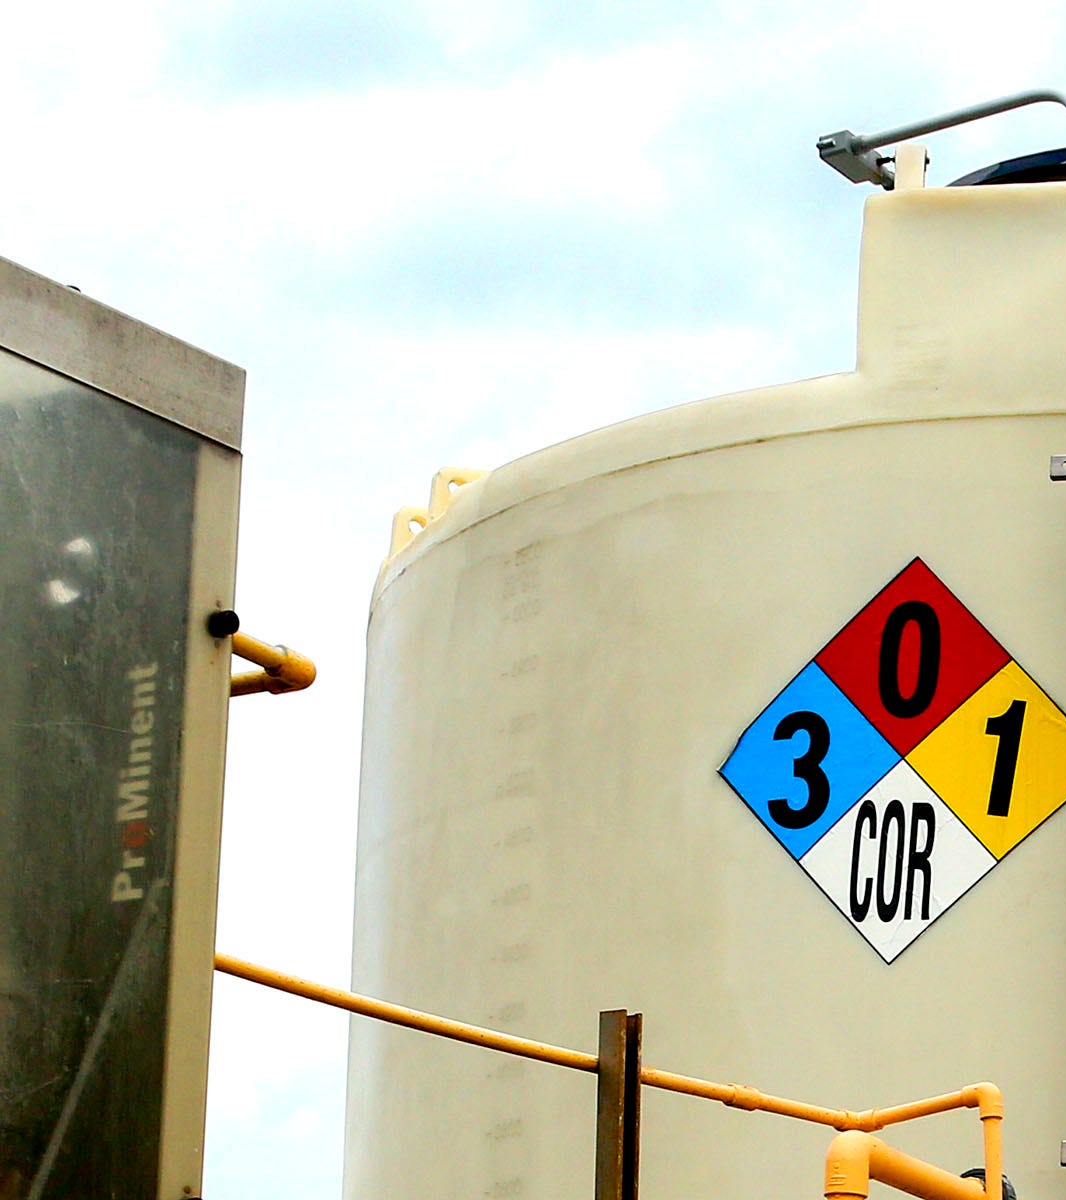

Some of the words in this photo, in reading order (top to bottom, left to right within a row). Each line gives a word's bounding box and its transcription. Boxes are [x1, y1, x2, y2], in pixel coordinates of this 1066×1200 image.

[878, 600, 941, 719] 0
[111, 661, 159, 902] ProMinent
[767, 711, 831, 830] 3
[984, 699, 1027, 818] 1
[849, 799, 936, 923] COR
